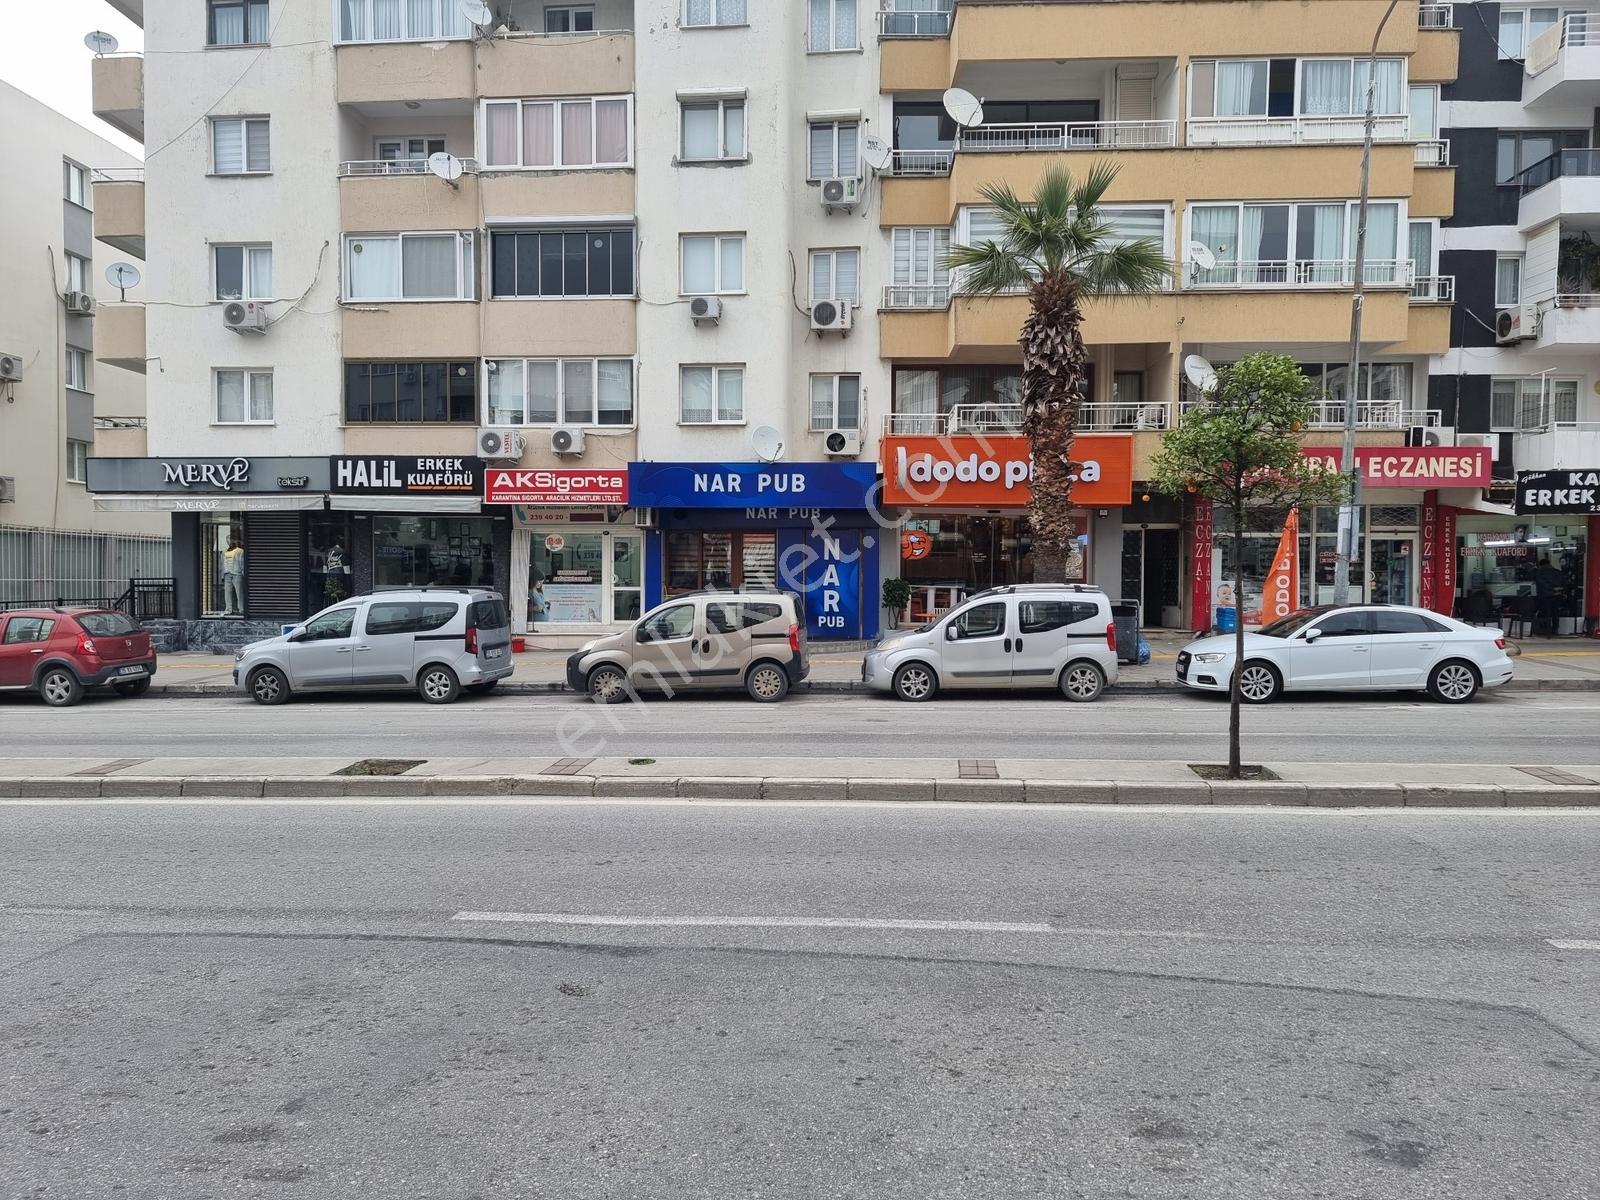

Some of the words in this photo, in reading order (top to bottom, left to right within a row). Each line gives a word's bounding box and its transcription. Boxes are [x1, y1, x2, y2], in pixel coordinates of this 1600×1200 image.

[417, 458, 463, 470] ERKEK
[1368, 453, 1482, 478] ECZANESİ
[160, 457, 249, 490] MERVE
[407, 471, 473, 486] KUAFÖRÜ
[493, 472, 623, 492] AKSigorta
[694, 474, 741, 493] NAR
[757, 474, 806, 493] PUB
[175, 500, 219, 511] MERVE
[1525, 489, 1595, 506] ERKEK
[746, 507, 778, 519] NAR
[788, 507, 821, 519] PUB
[1423, 507, 1434, 609] ECZANE
[823, 538, 841, 613] NAR
[818, 615, 845, 628] PUB
